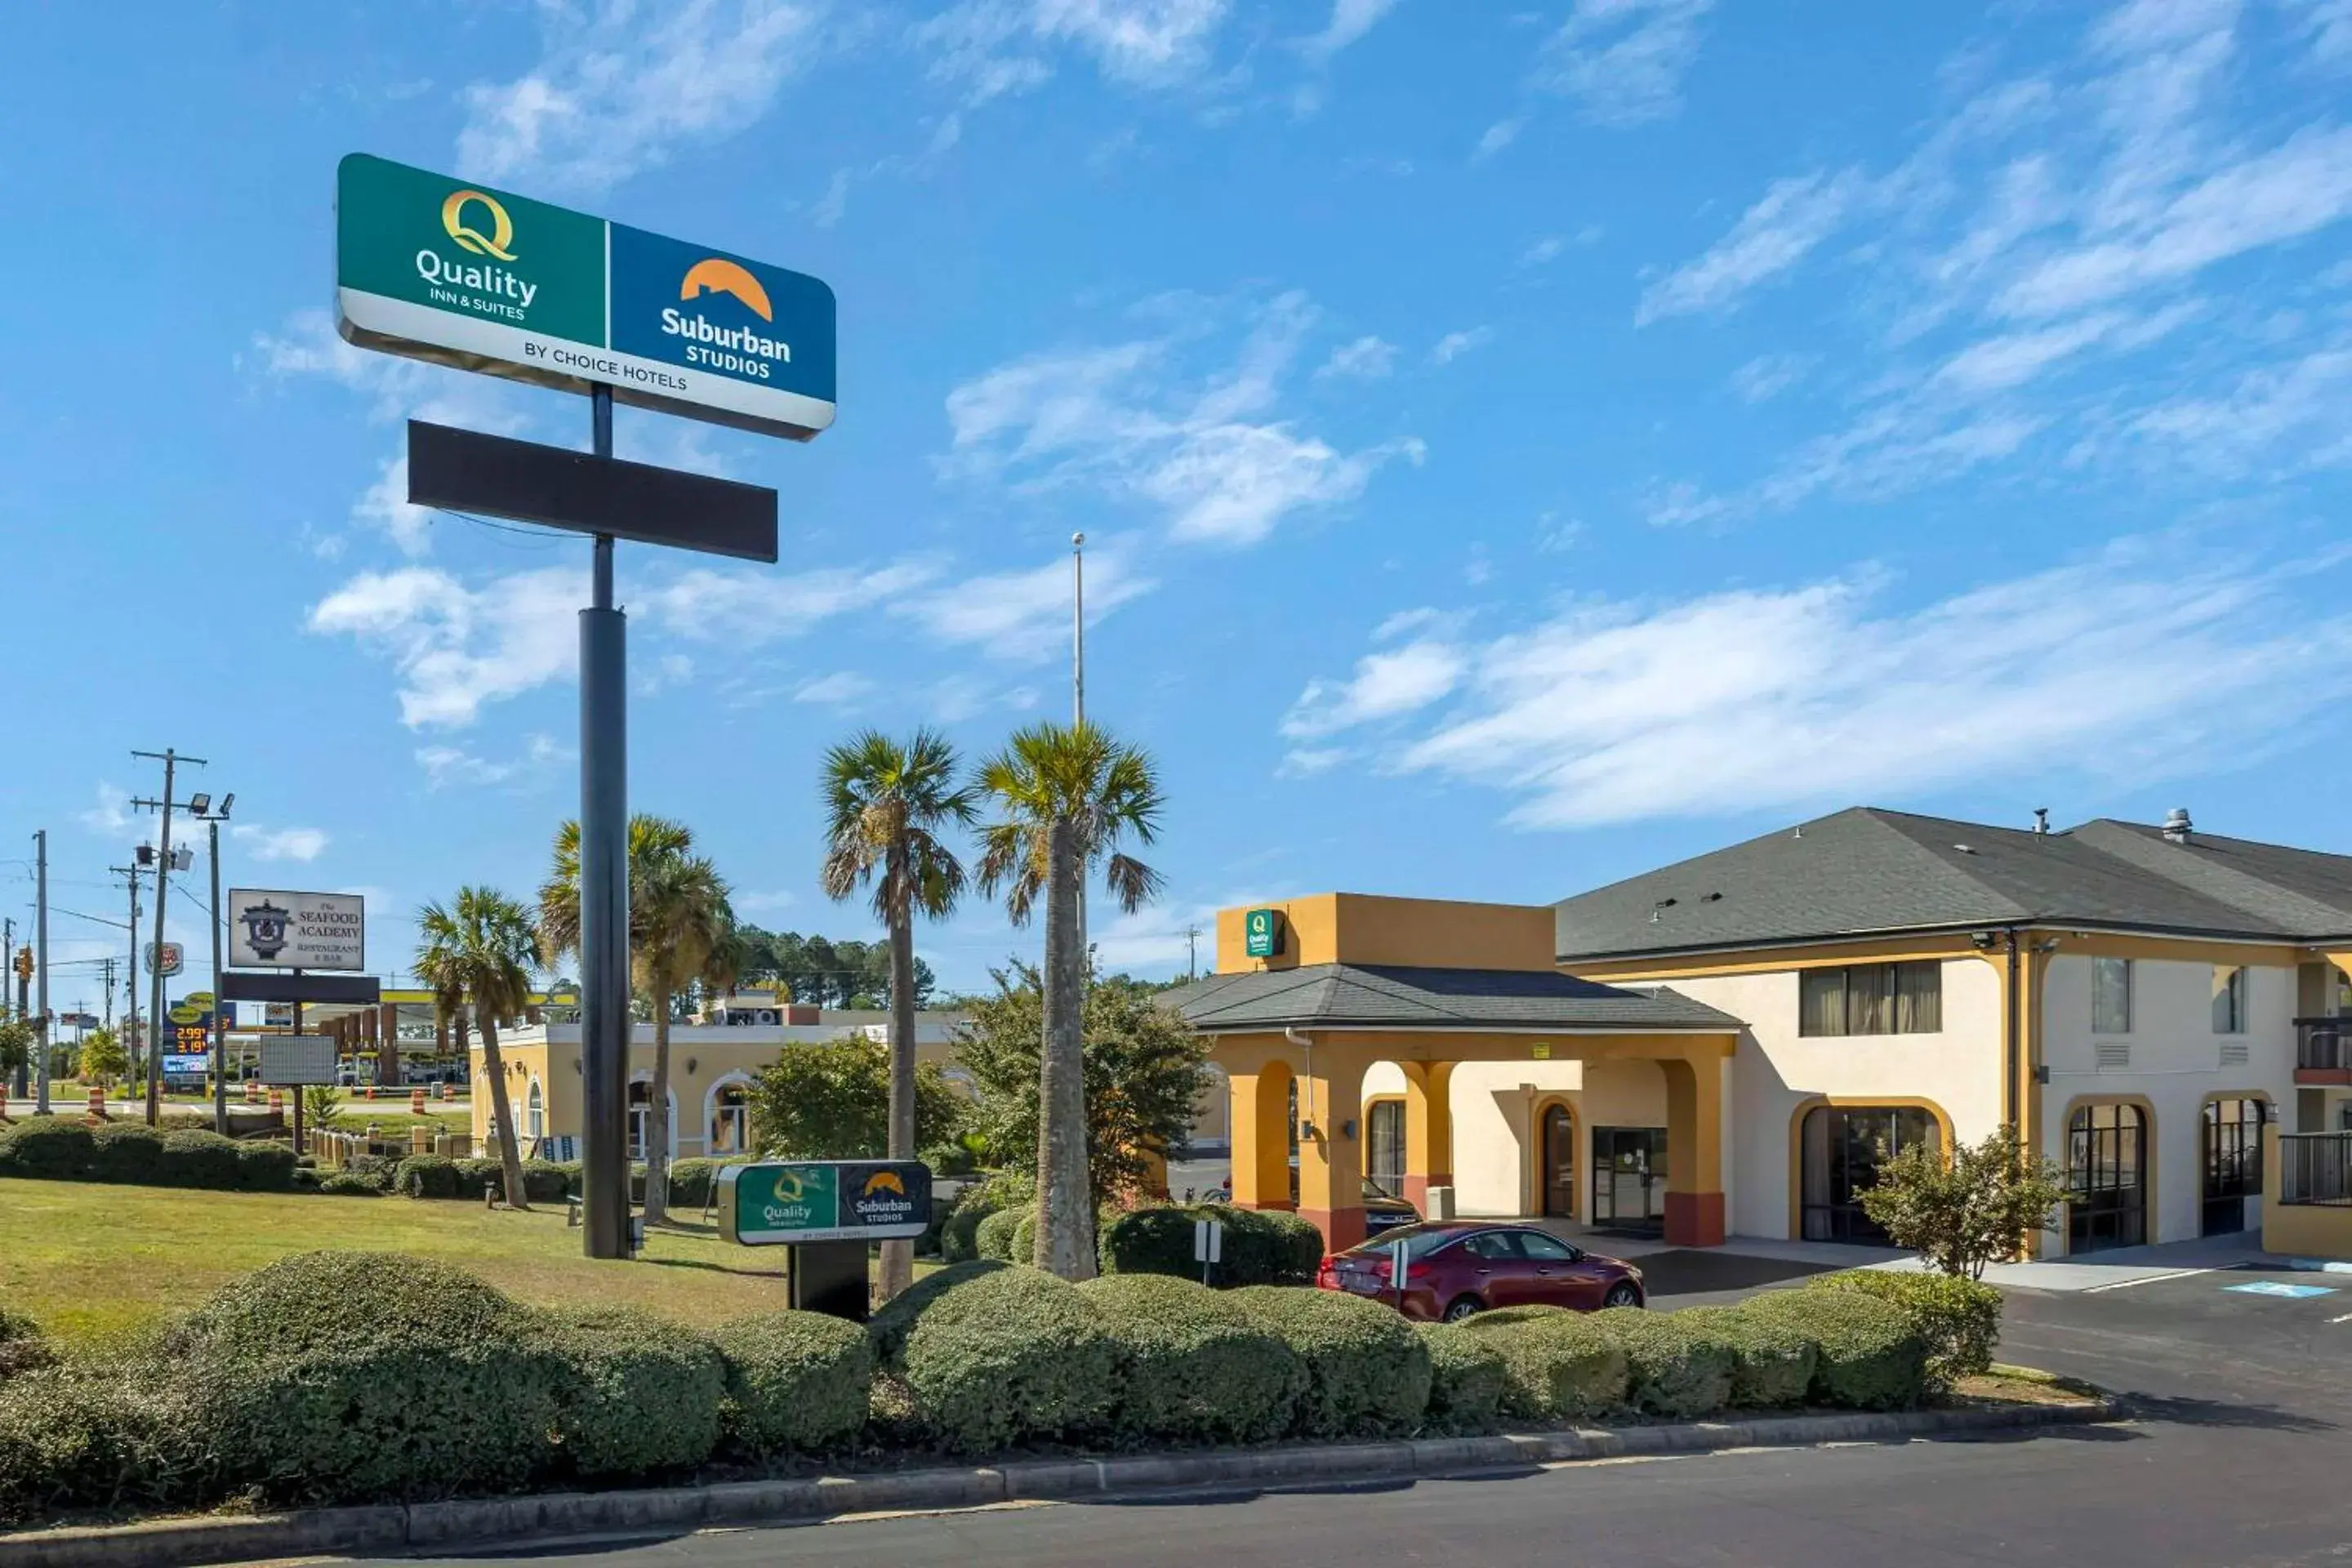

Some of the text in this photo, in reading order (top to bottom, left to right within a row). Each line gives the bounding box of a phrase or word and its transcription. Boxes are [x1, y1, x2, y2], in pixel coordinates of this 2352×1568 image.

[416, 249, 537, 308] Quality
[430, 287, 525, 321] INN & SUITES
[661, 308, 791, 363] Suburban
[524, 342, 688, 391] BY CHOICE HOTELS
[685, 345, 770, 379] STUDIOS
[300, 911, 359, 924] SEAFOOD
[298, 926, 360, 938] ACADEMY
[763, 1205, 812, 1219] Quality
[856, 1199, 912, 1214] Suburban
[866, 1214, 902, 1223] STUDIOS
